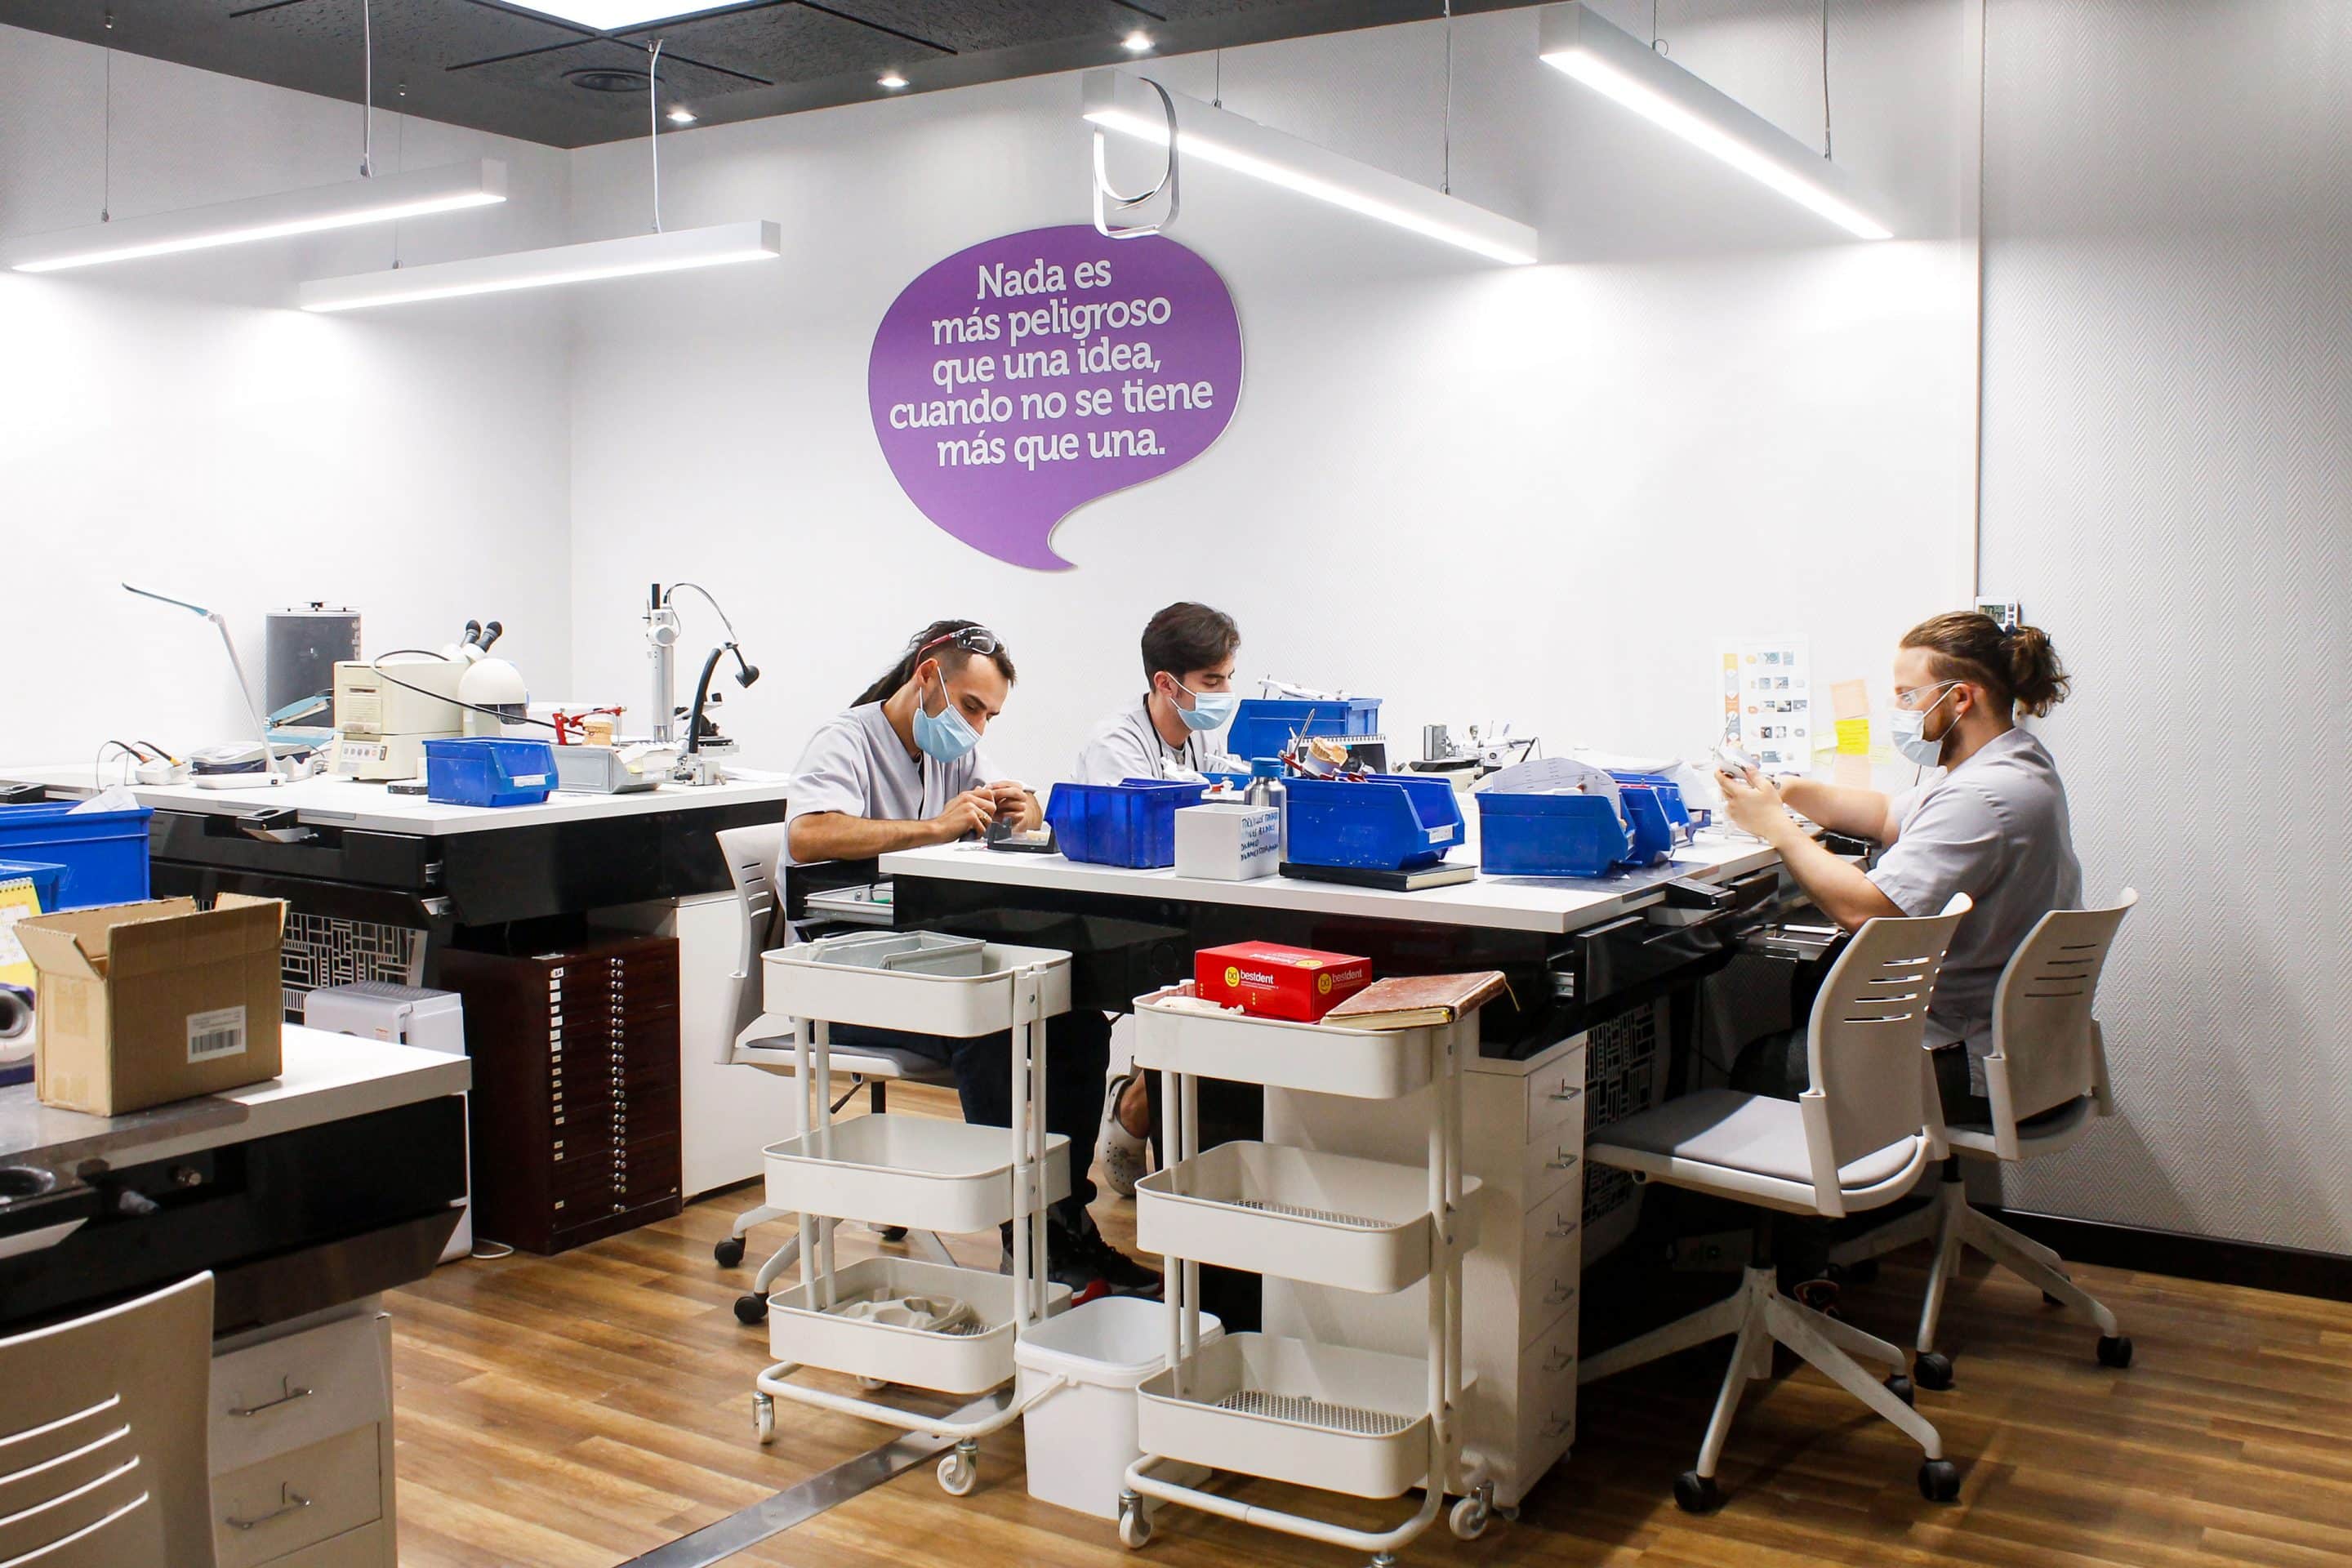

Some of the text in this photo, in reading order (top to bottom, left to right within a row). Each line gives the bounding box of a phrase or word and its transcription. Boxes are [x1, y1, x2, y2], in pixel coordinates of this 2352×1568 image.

[978, 259, 1112, 300] Nada es
[932, 296, 1171, 346] más peligroso
[933, 336, 1161, 393] que una idea,
[889, 379, 1214, 430] cuando no se tiene
[938, 429, 1165, 471] más que una.
[1241, 969, 1274, 984] bestdent
